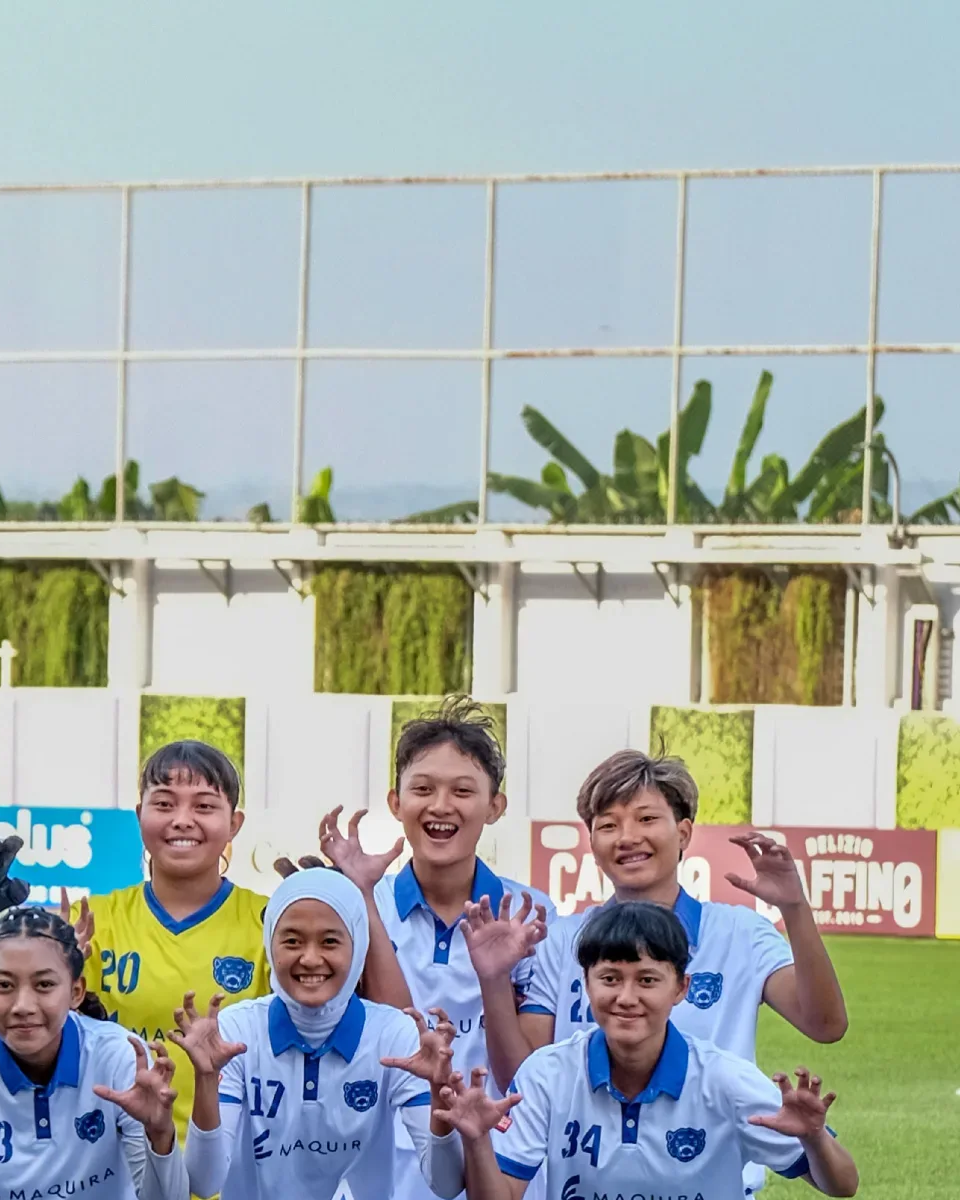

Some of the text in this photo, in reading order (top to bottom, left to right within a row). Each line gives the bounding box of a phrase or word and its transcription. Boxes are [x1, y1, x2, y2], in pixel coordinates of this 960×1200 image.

[101, 950, 140, 994] 20
[250, 1077, 285, 1118] 17
[561, 1120, 602, 1168] 34
[9, 1167, 115, 1200] MAQUIRA
